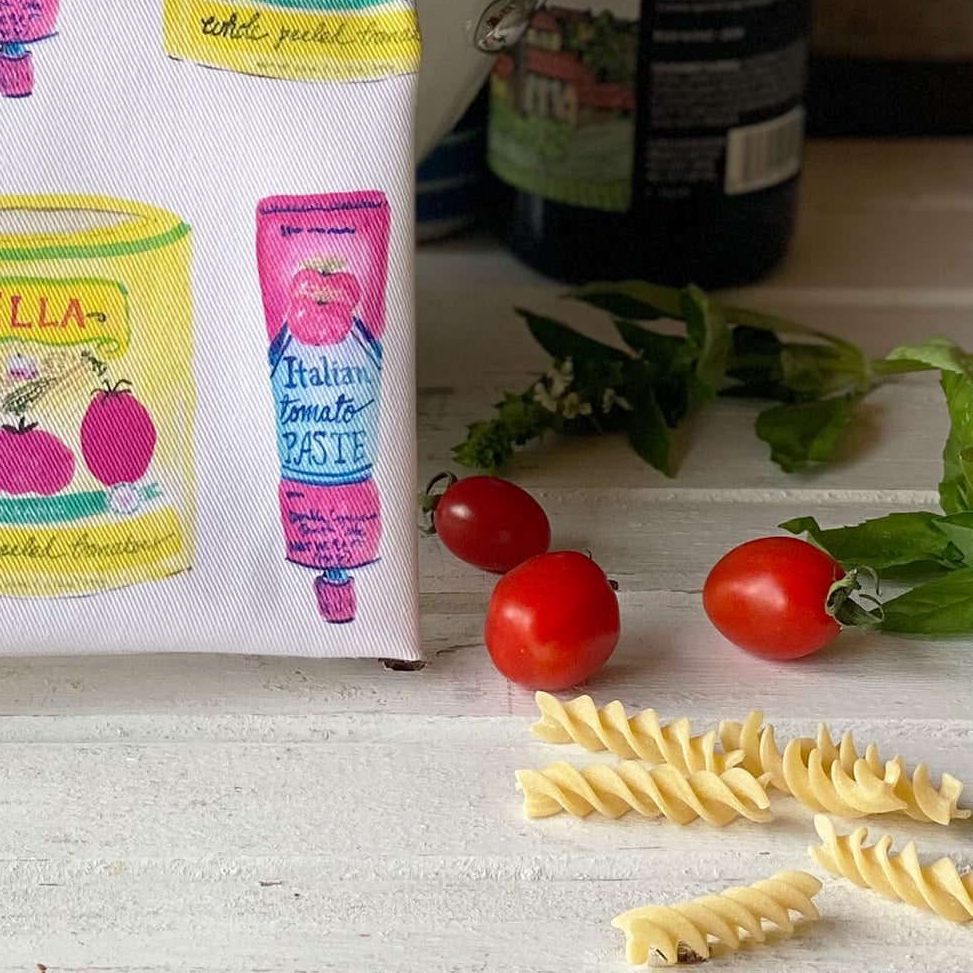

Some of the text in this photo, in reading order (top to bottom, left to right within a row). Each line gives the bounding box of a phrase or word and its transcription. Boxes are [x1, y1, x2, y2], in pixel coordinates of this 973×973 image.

[273, 22, 357, 51] peeled
[283, 356, 374, 389] Italian
[280, 394, 375, 425] tomato
[282, 430, 368, 465] PASTE
